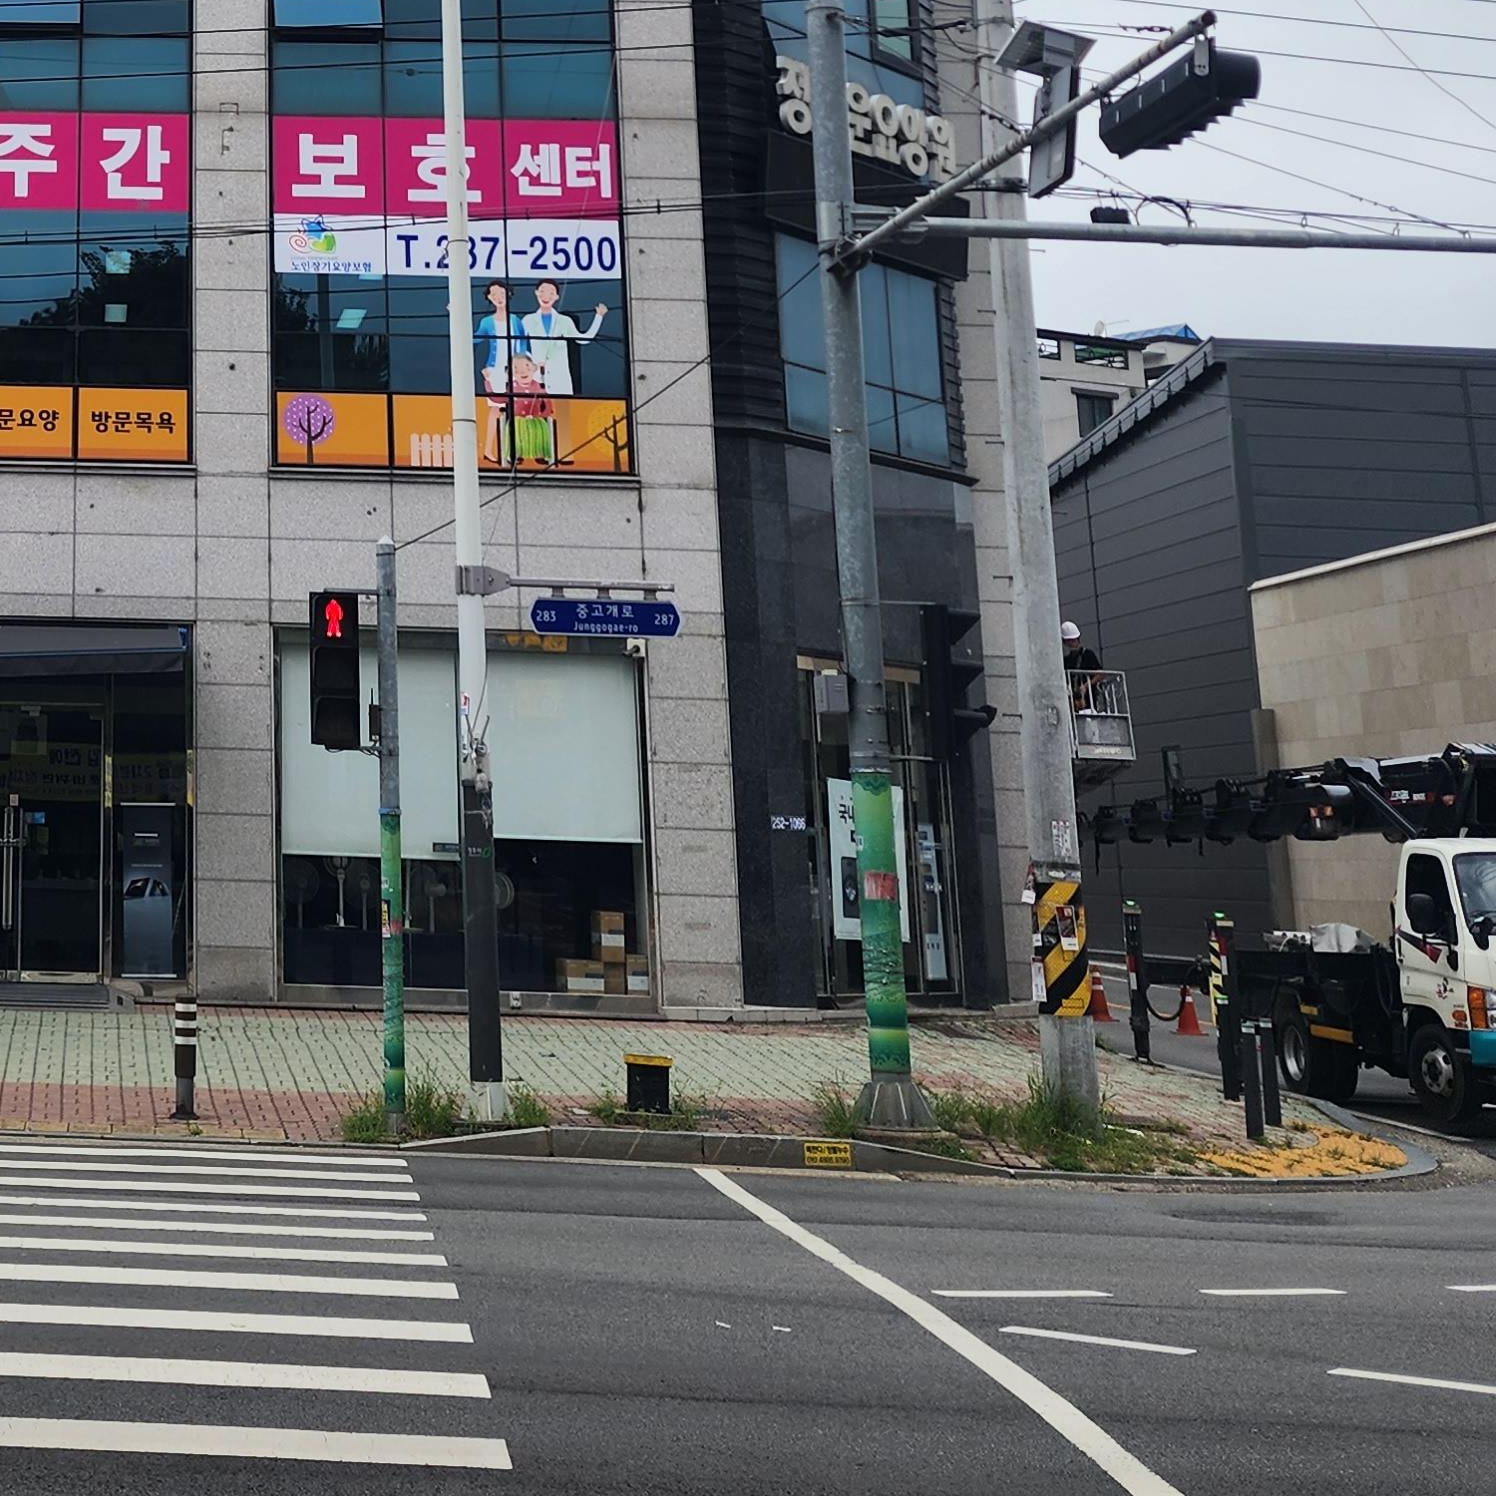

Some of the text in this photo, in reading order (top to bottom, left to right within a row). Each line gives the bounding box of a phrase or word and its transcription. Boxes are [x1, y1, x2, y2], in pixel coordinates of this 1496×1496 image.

[775, 55, 957, 184] 정운요양원
[90, 410, 177, 435] 방문목욕
[576, 603, 635, 619] 중고개로
[573, 621, 639, 633] Junggogae-ro
[654, 614, 675, 625] 287
